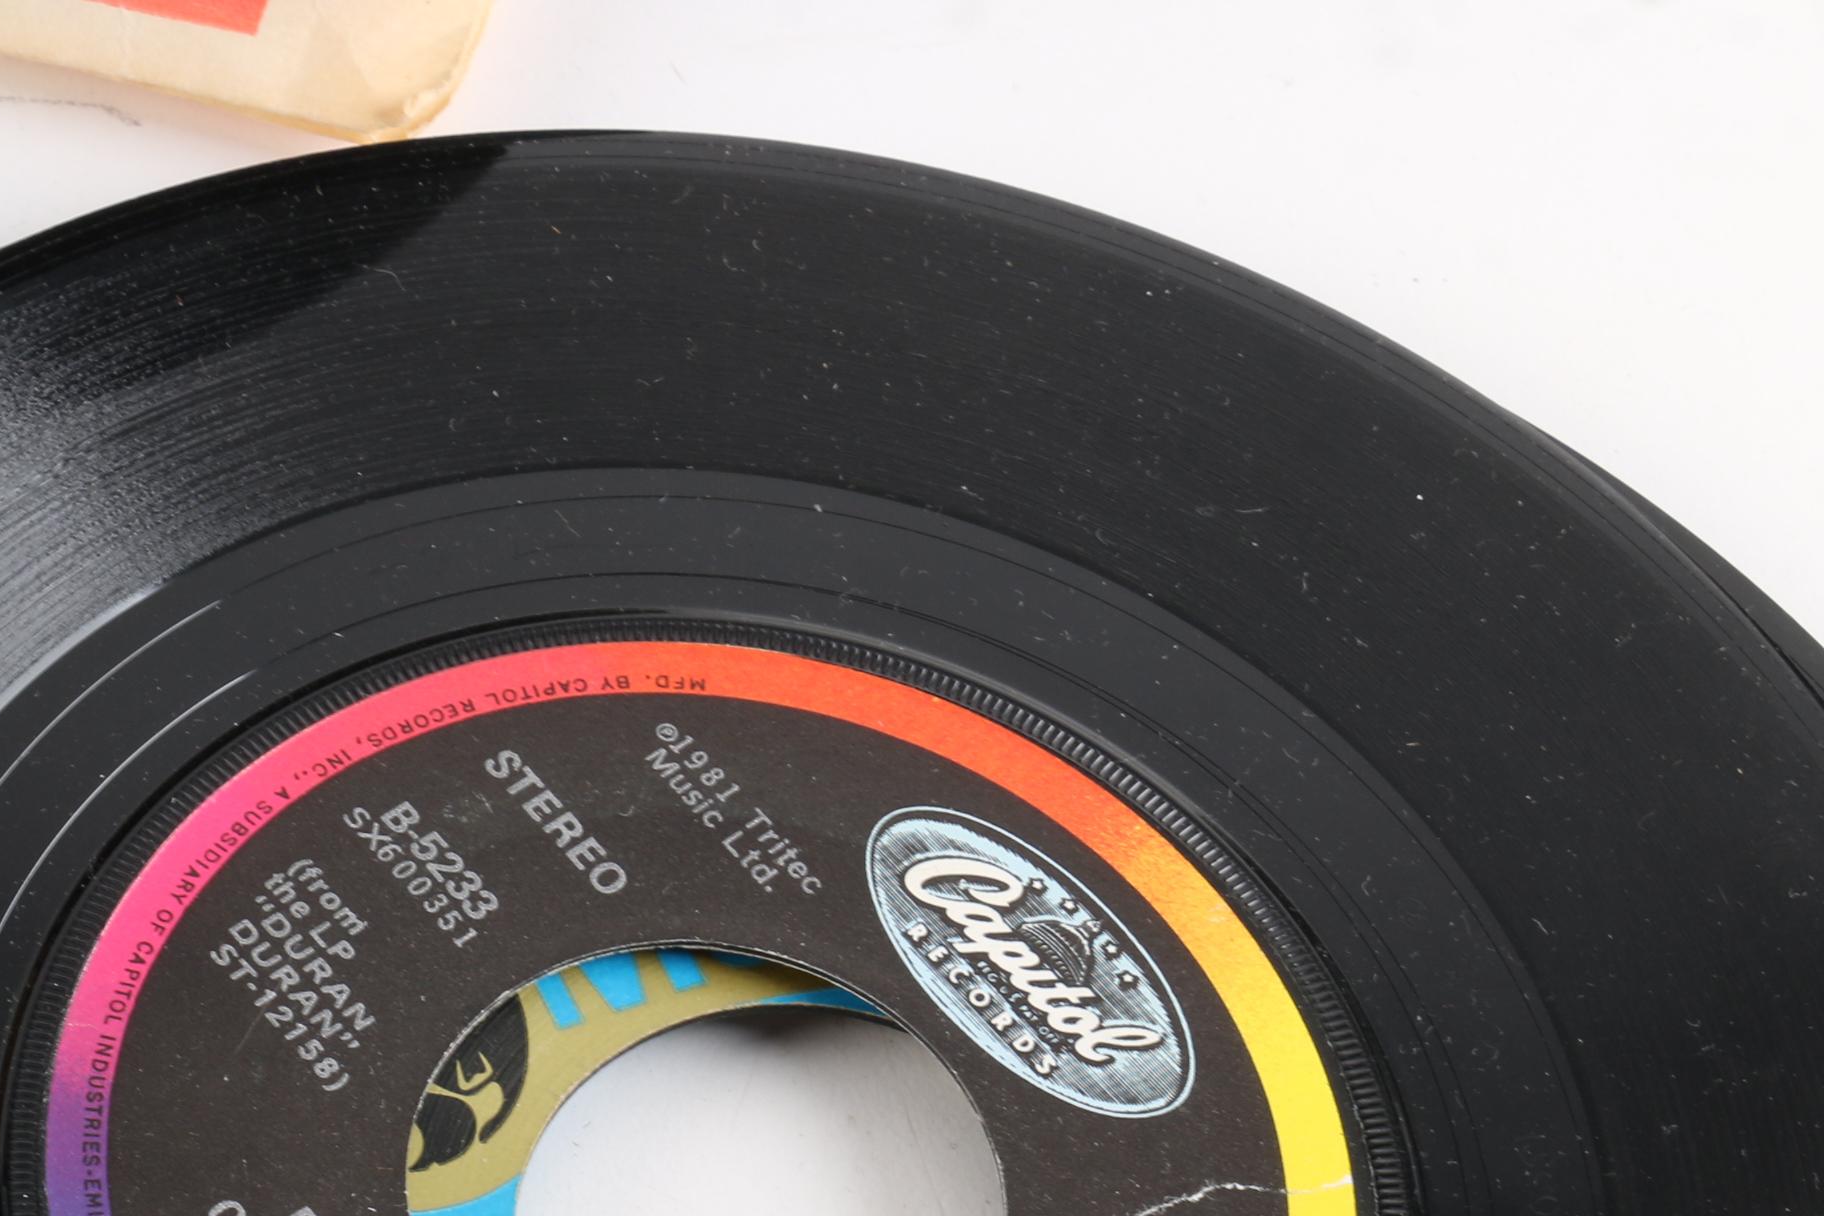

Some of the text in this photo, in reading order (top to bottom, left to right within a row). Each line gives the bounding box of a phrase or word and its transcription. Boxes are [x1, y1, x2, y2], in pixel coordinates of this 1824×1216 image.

[356, 699, 476, 748] RECORDS,
[485, 678, 587, 705] CAPITOL
[600, 676, 631, 691] BY
[645, 674, 706, 692] MFD.
[275, 787, 291, 801] A
[293, 749, 351, 782] INC.,
[171, 801, 274, 906] SUBSIDIARY
[380, 801, 499, 920] B-5233
[484, 750, 627, 895] STEREO
[644, 748, 779, 892] Music Ltd.
[745, 807, 822, 895] Tritec
[264, 872, 356, 960] the LP
[286, 859, 369, 936] (from
[342, 806, 477, 948] SX600351
[150, 908, 174, 937] OF
[903, 855, 1164, 1062] Capitol
[103, 940, 154, 1025] CAPITOL
[209, 943, 350, 1092] ST-12158)
[906, 922, 1058, 1075] RECORDS
